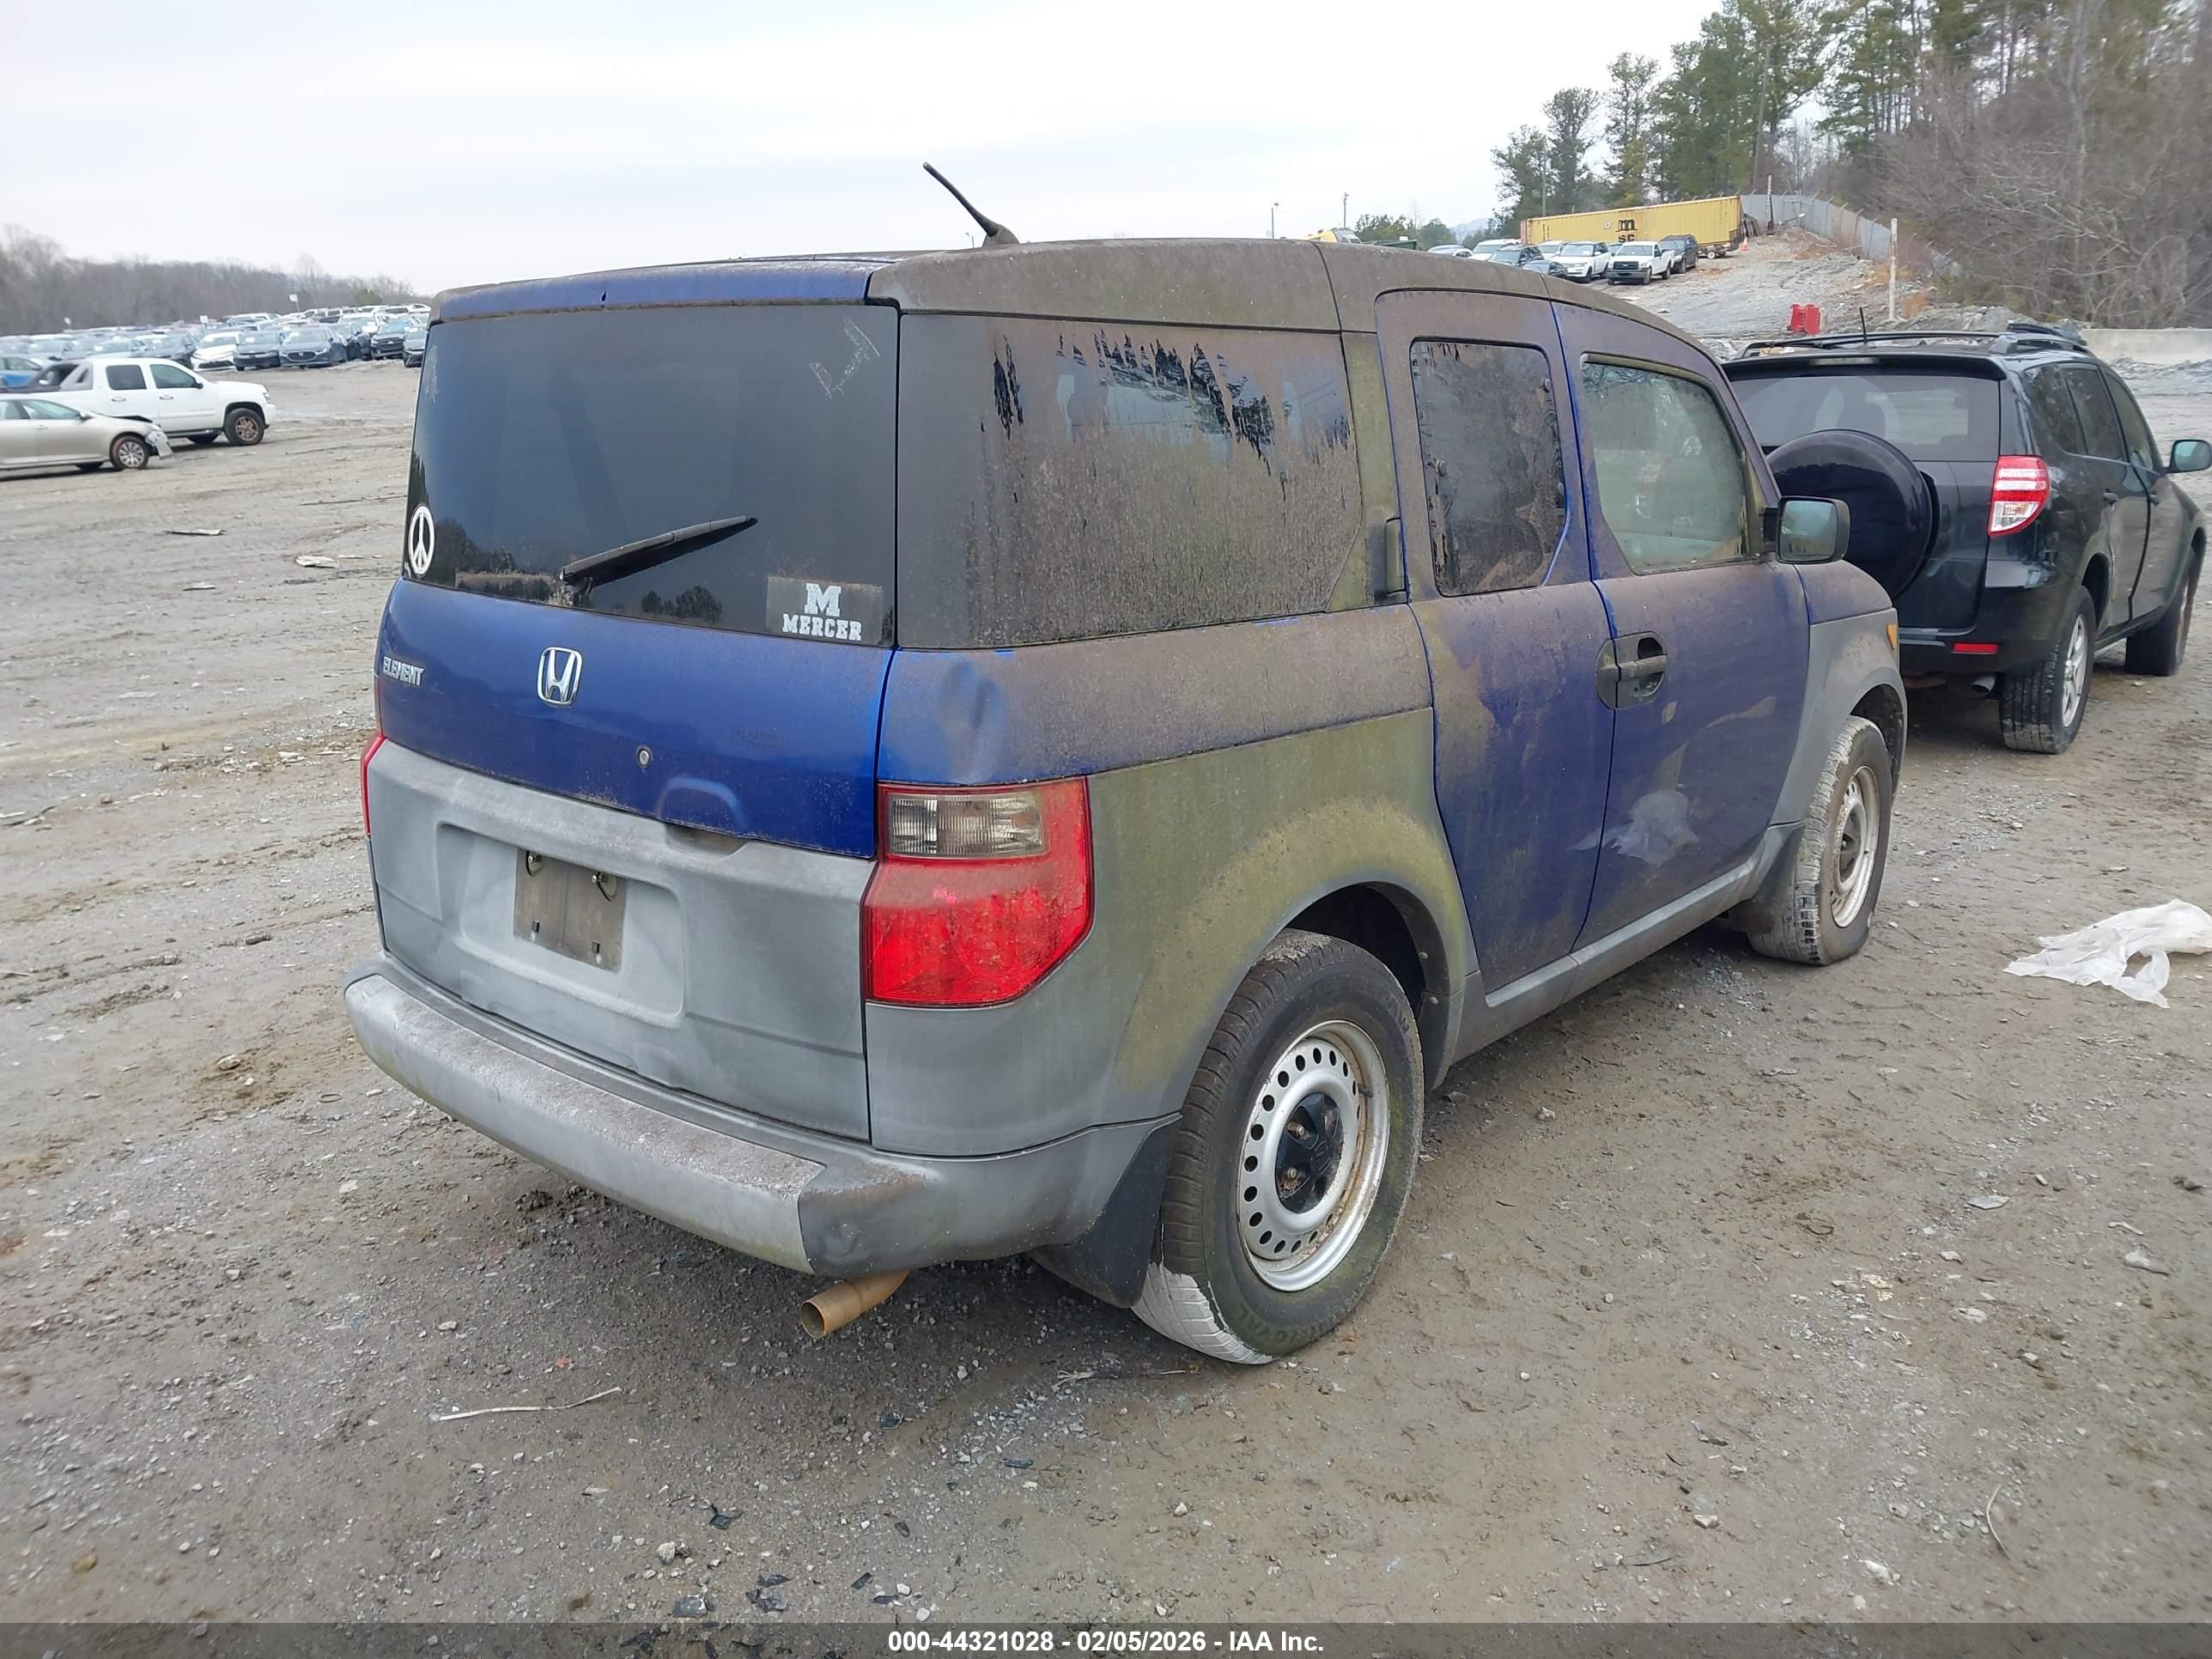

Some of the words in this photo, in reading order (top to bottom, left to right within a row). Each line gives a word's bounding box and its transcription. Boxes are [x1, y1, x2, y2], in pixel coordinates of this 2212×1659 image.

[804, 582, 842, 617] M
[782, 613, 862, 641] MERCER
[382, 655, 425, 686] ELEMENT
